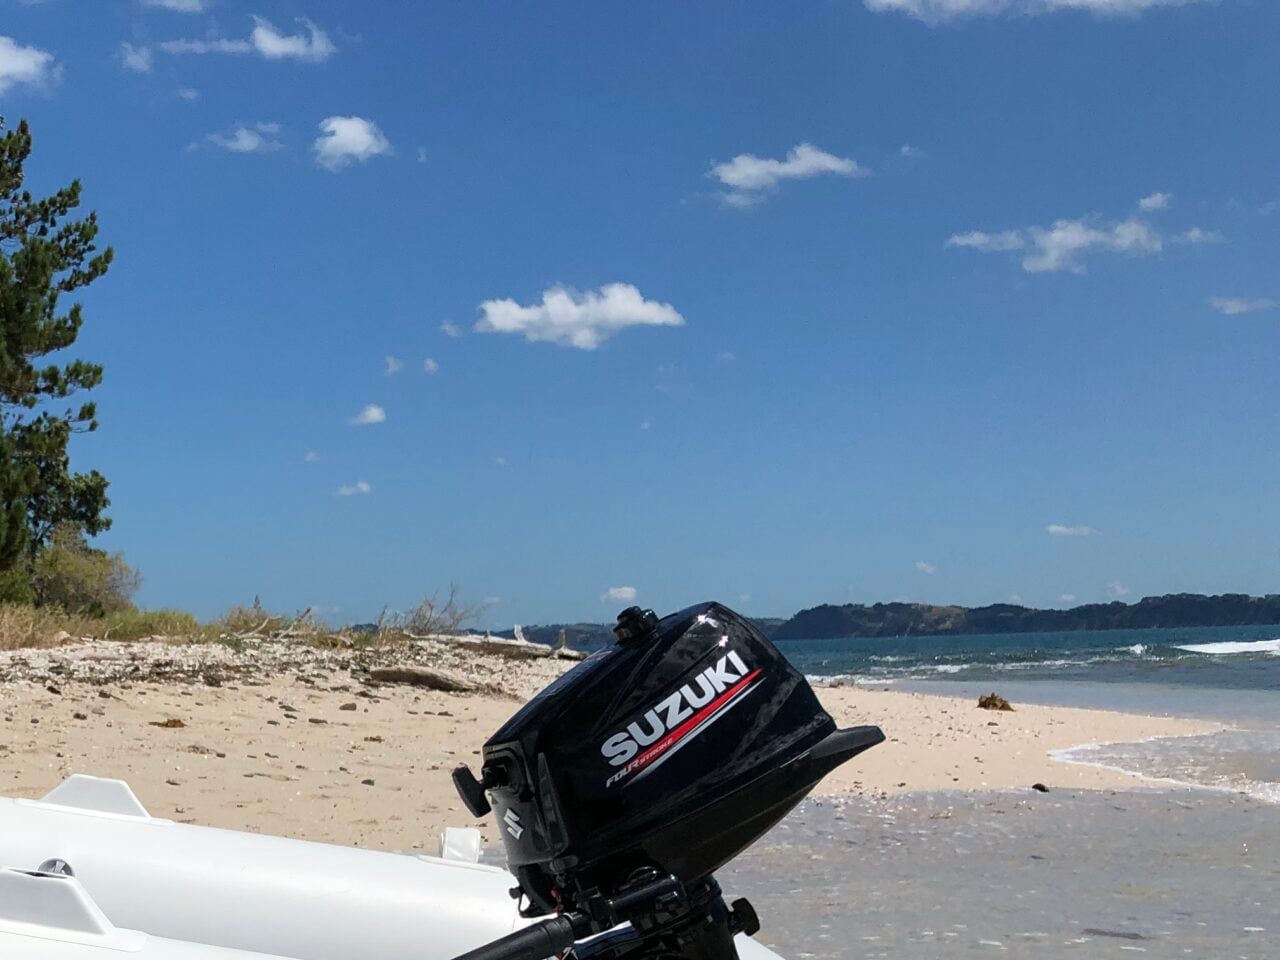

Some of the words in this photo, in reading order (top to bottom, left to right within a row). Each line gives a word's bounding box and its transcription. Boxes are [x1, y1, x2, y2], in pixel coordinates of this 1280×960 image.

[601, 650, 749, 766] SUZUKI
[606, 758, 640, 788] FOUR
[639, 737, 673, 763] STROKE
